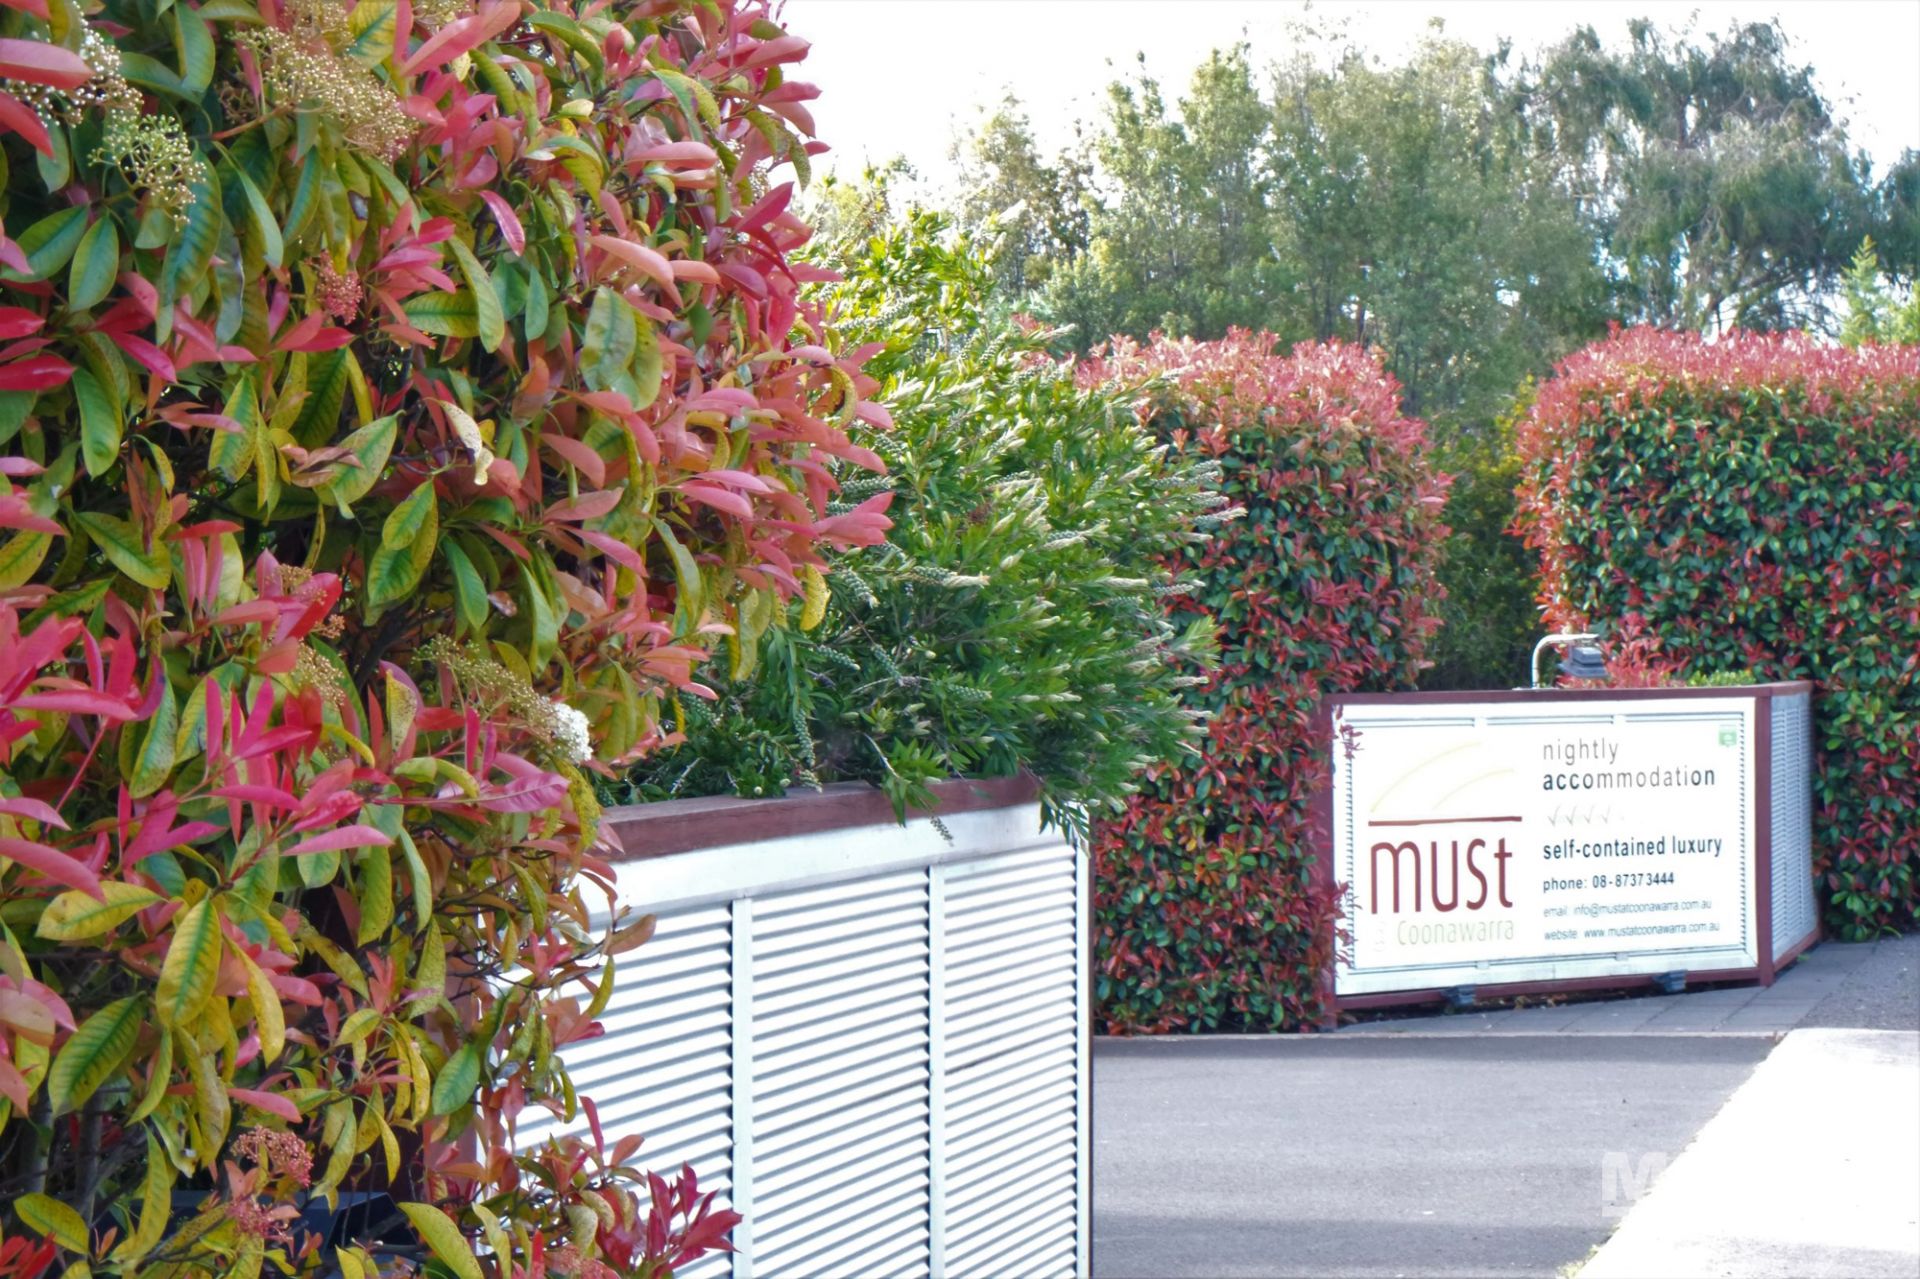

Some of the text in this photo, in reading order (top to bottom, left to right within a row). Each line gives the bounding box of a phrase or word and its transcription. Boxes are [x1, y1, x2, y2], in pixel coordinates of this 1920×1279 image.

[1543, 737, 1618, 765] nightly
[1543, 765, 1715, 790] accommodation
[1543, 836, 1722, 860] self-contained luxury
[1543, 877, 1587, 893] phone:
[1397, 919, 1515, 946] Coonawarra
